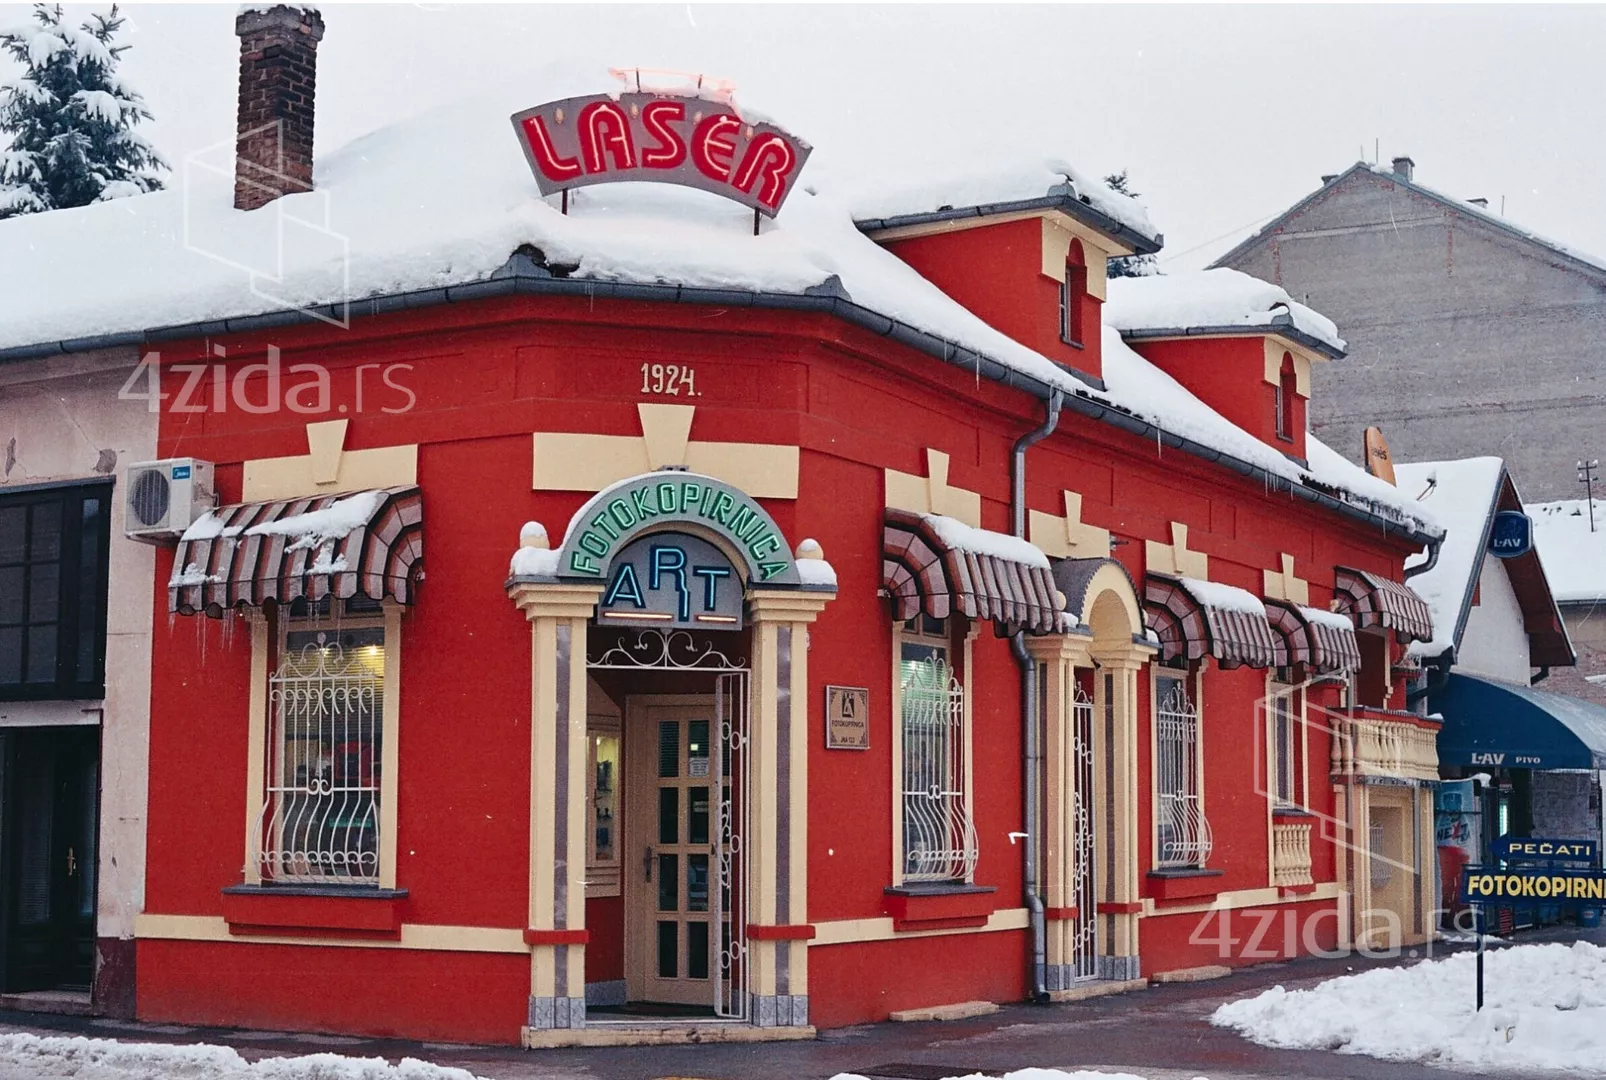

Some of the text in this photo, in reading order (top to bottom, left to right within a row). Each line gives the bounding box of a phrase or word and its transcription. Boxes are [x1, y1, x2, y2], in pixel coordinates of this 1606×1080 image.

[521, 101, 797, 209] LASER
[640, 363, 702, 396] 1924.
[570, 482, 789, 581] FOTOKOPIRNICA
[601, 544, 731, 622] ART
[1515, 756, 1541, 764] PIVO
[1509, 842, 1590, 856] PEČATI
